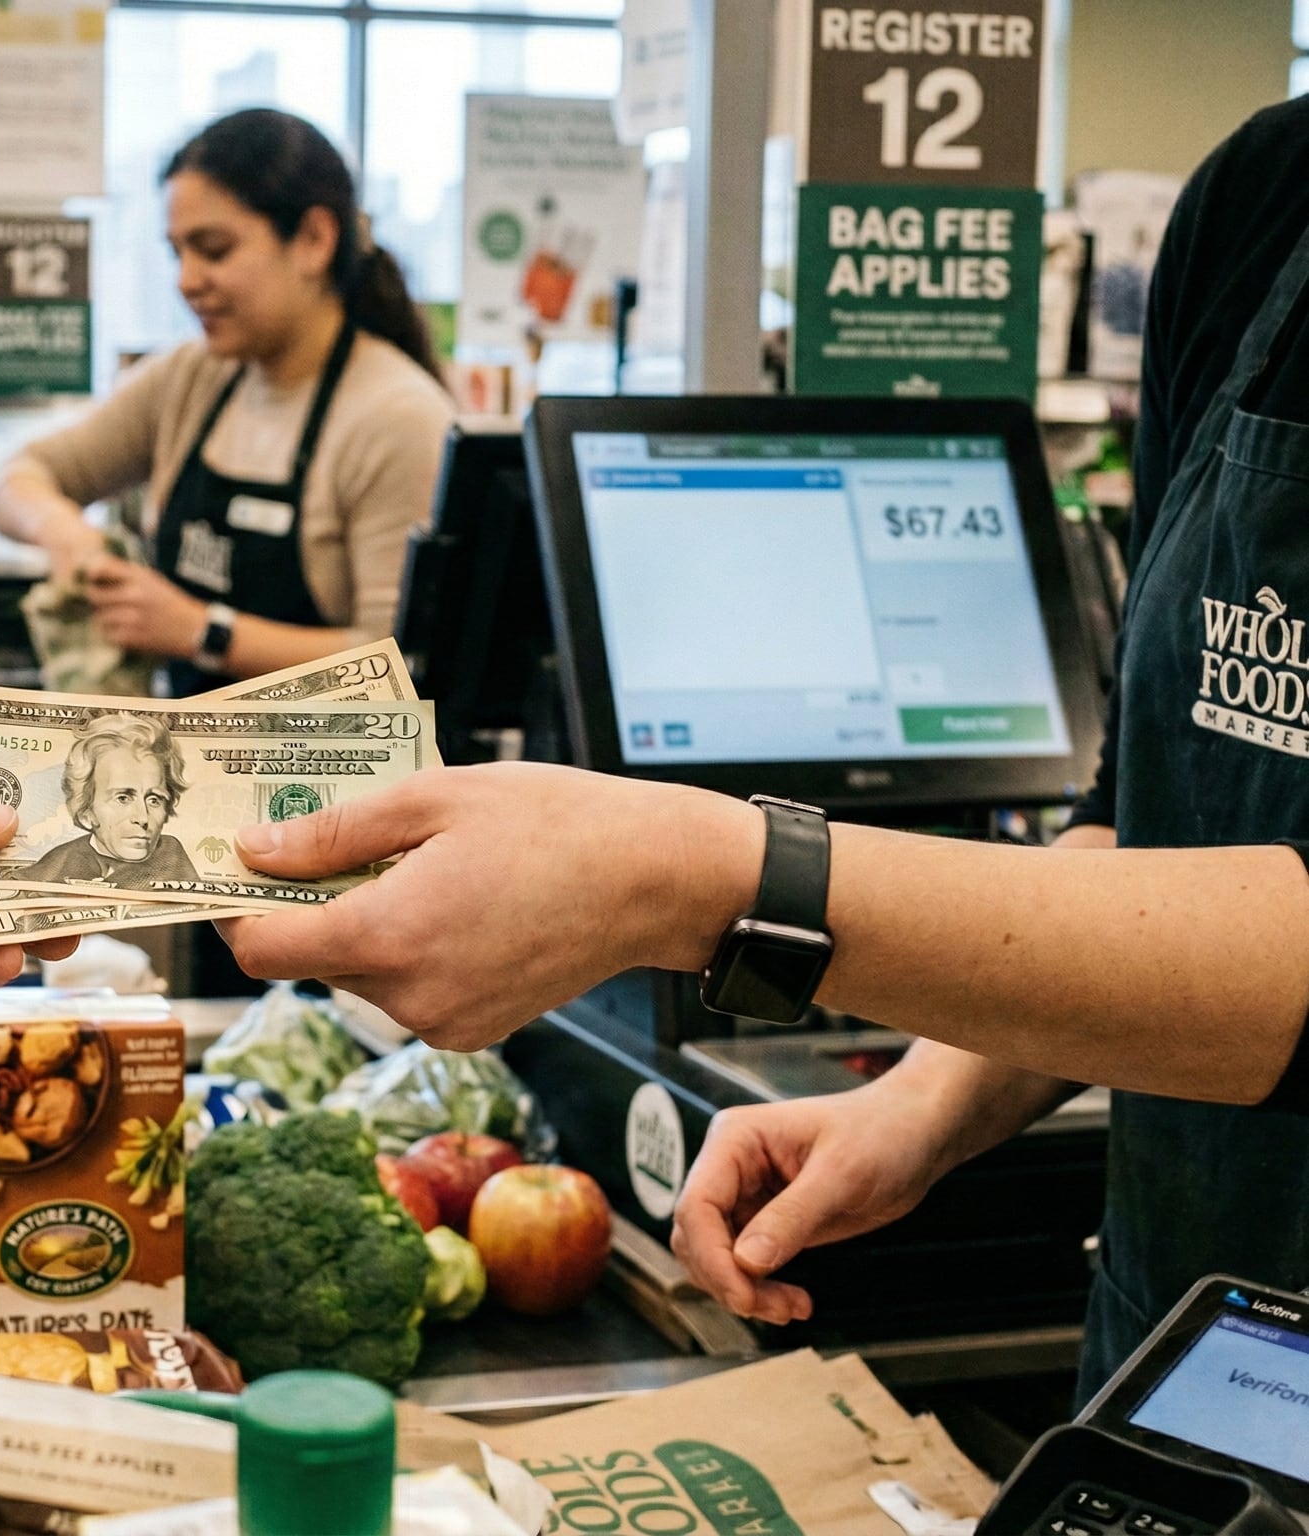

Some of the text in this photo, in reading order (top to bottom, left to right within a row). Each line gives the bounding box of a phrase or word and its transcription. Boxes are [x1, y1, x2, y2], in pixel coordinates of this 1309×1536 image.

[820, 8, 1033, 57] REGISTER
[863, 66, 984, 170] 12
[828, 205, 1014, 251] BAG FEE
[826, 254, 1011, 299] APPLIES
[885, 505, 1004, 539] $67.43
[1202, 596, 1309, 670] WHOL
[336, 652, 391, 688] 20
[364, 713, 421, 739] 20
[5, 1207, 126, 1246] NATURE'S PATH
[1228, 1367, 1309, 1407] VeriFon
[2, 1435, 177, 1477] BAG FEE APPLIES
[521, 1451, 623, 1536] OLE
[582, 1449, 698, 1536] ODS
[674, 1447, 775, 1536] ARKET
